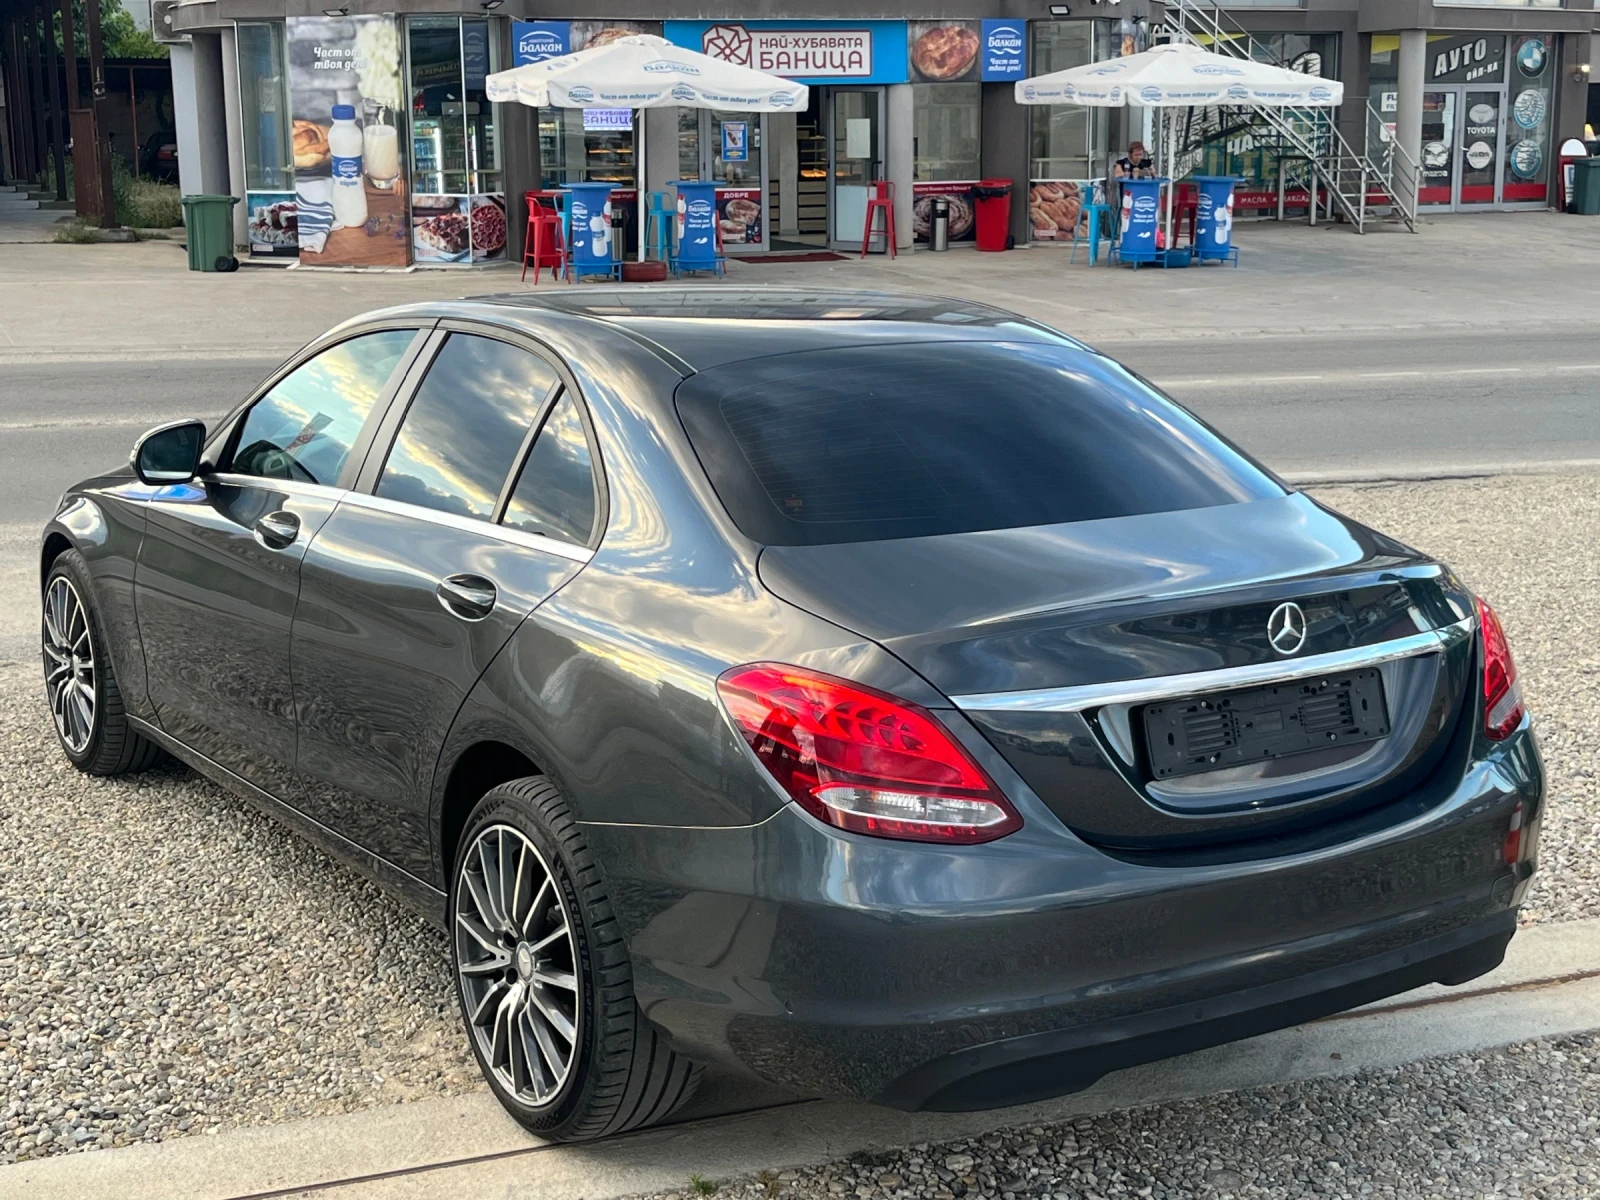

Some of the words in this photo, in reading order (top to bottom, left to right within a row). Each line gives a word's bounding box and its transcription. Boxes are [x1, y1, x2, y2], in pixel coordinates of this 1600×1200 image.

[519, 41, 562, 53] Балкан
[760, 35, 863, 48] НАЙ-ХУБАВАТА
[988, 36, 1022, 47] Балкан
[314, 47, 342, 57] Част
[344, 49, 361, 57] от
[1434, 38, 1487, 77] АУТО
[314, 60, 342, 69] твоя
[760, 51, 863, 72] БАНИЦА
[1466, 61, 1498, 81] ОЙЛ-КА
[671, 88, 695, 96] Балкан
[1466, 126, 1496, 135] TOYOTA
[1422, 170, 1448, 178] mazda
[1241, 196, 1267, 204] МАСЛА
[562, 879, 591, 972] MICHELIN
